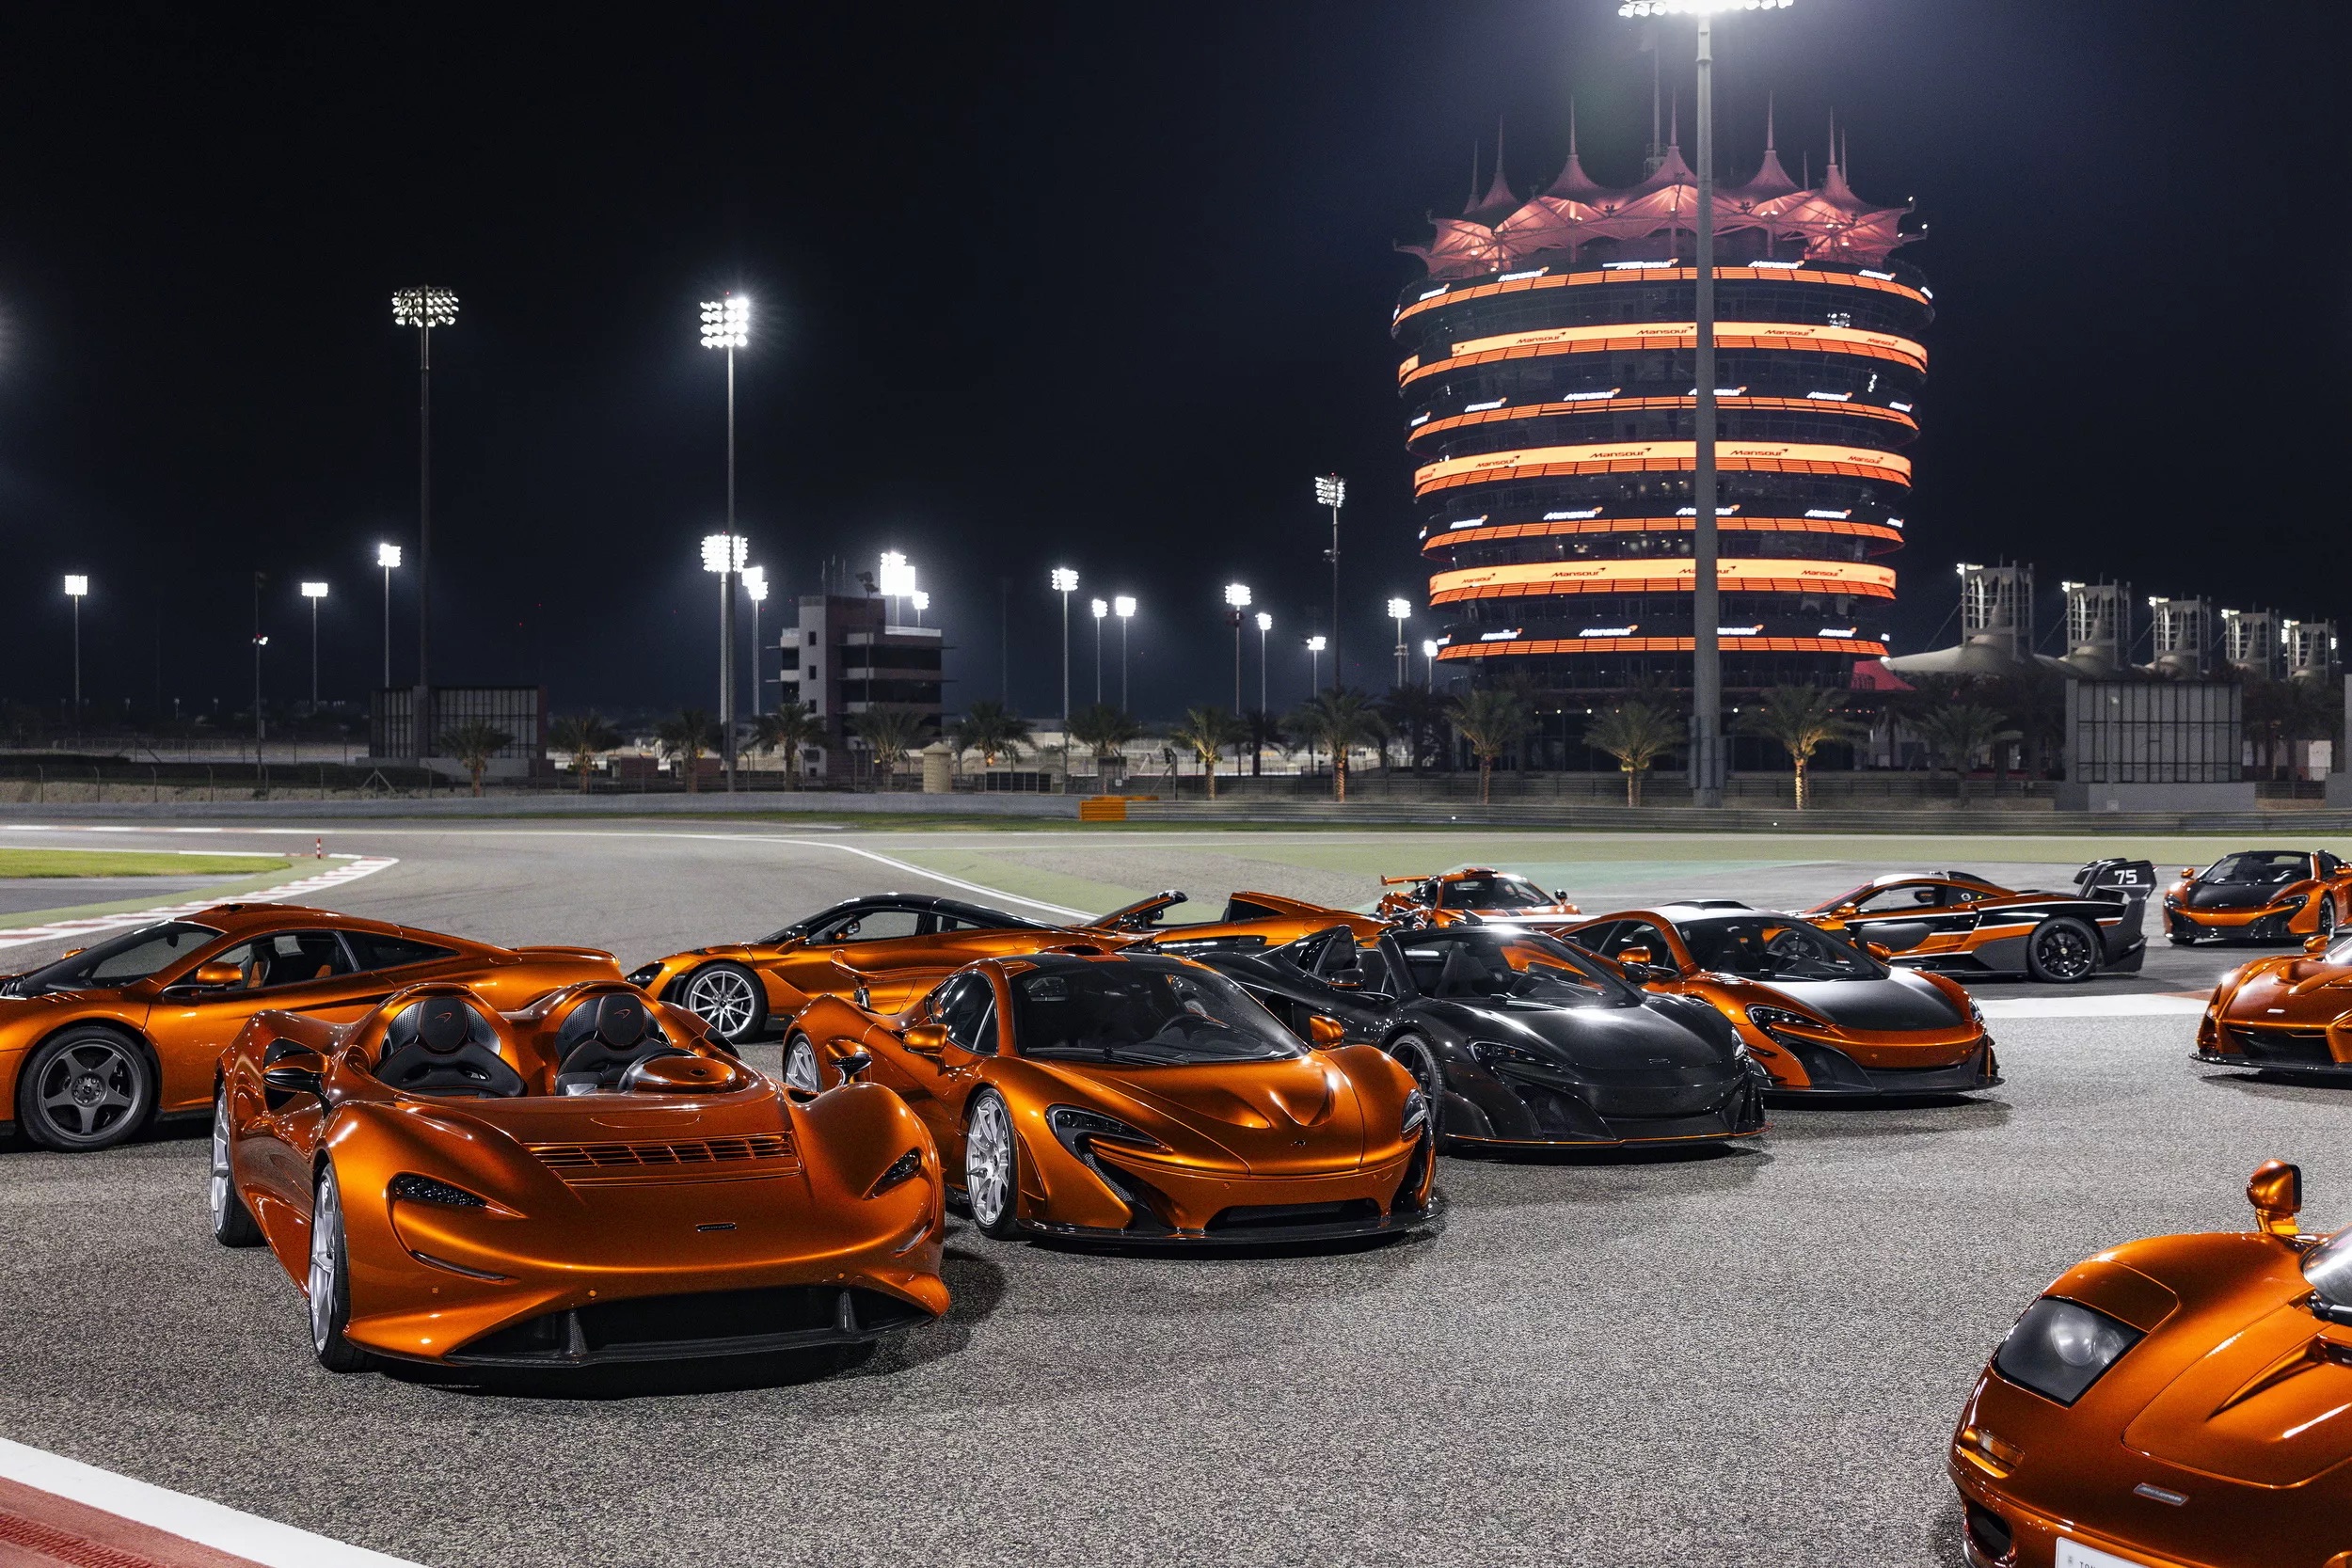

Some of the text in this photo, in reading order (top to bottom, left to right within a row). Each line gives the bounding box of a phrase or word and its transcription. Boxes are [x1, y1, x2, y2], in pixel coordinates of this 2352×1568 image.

[1516, 336, 1561, 344] Mansour
[1475, 459, 1516, 468] Mansour
[1461, 576, 1492, 584] Mansour
[2114, 869, 2137, 885] 75
